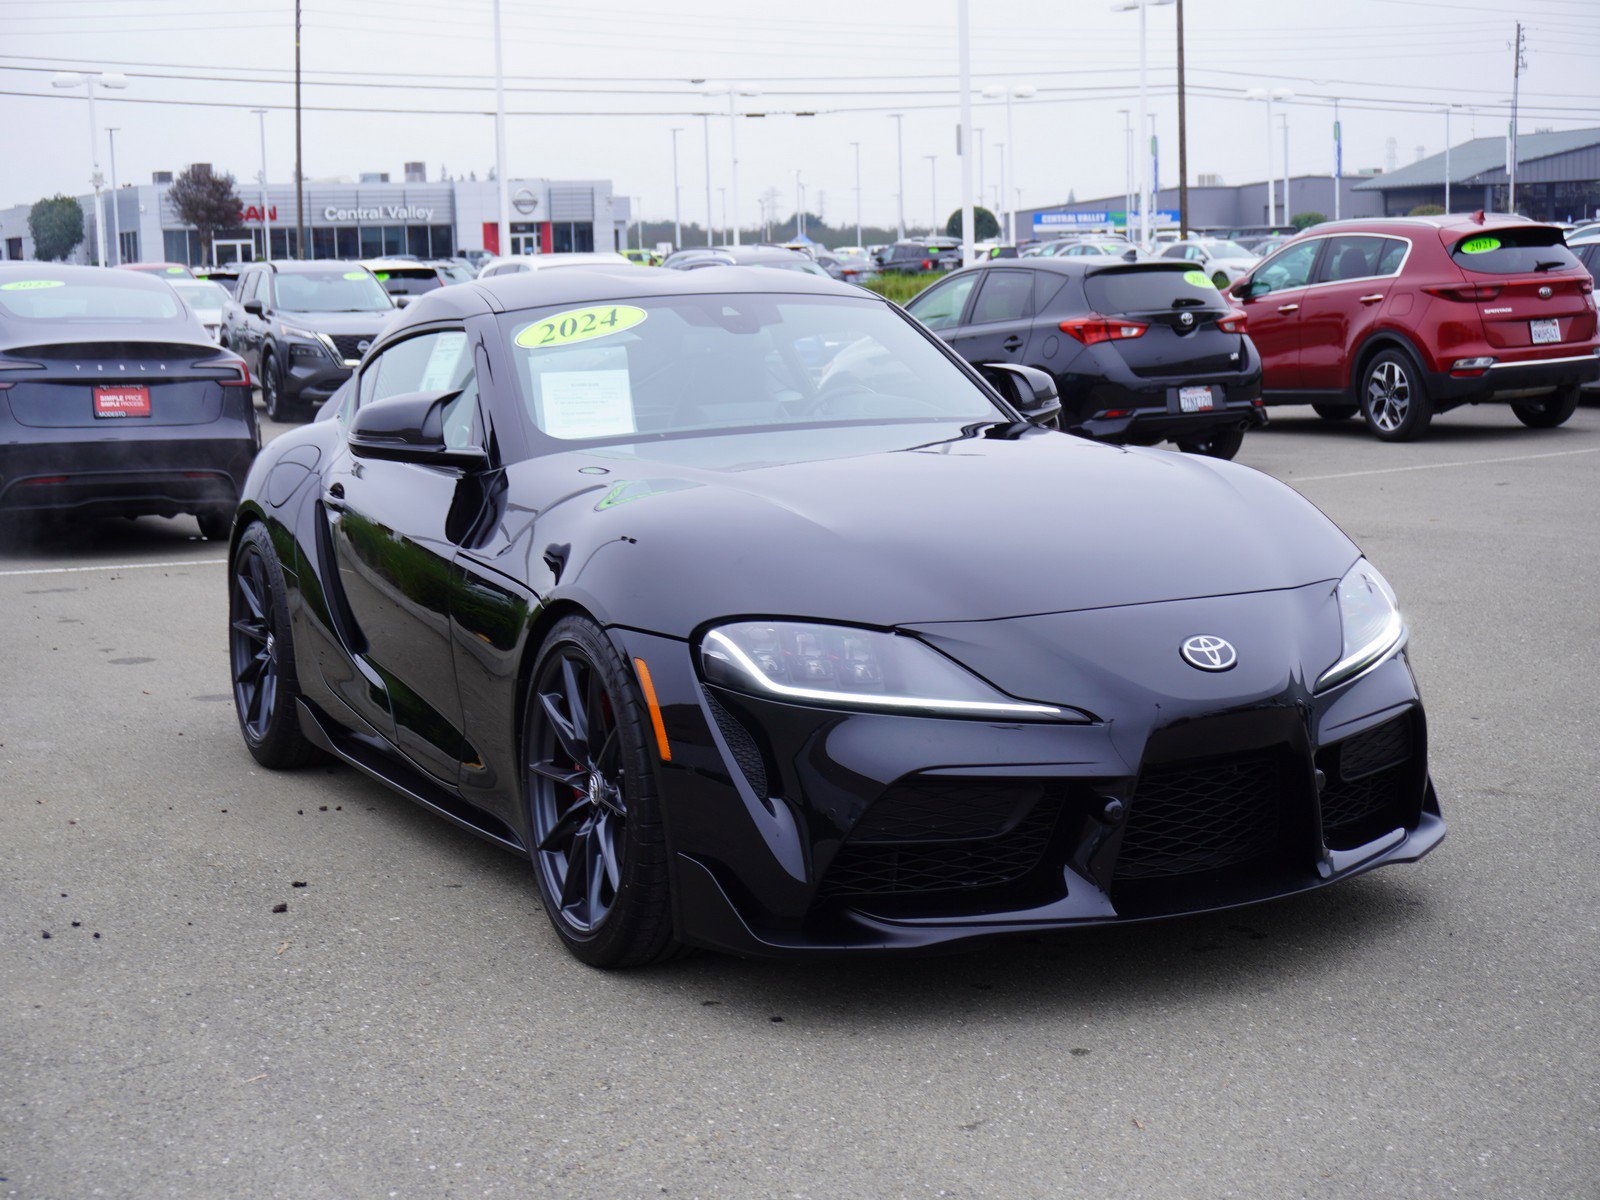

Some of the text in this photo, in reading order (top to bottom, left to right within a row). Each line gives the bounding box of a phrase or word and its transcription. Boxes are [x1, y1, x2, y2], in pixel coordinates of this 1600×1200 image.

[324, 206, 434, 221] Central Valley
[1041, 213, 1076, 224] CENTRAL
[1077, 213, 1106, 223] VALLEY
[1471, 239, 1493, 252] 2021
[539, 308, 619, 345] 2024
